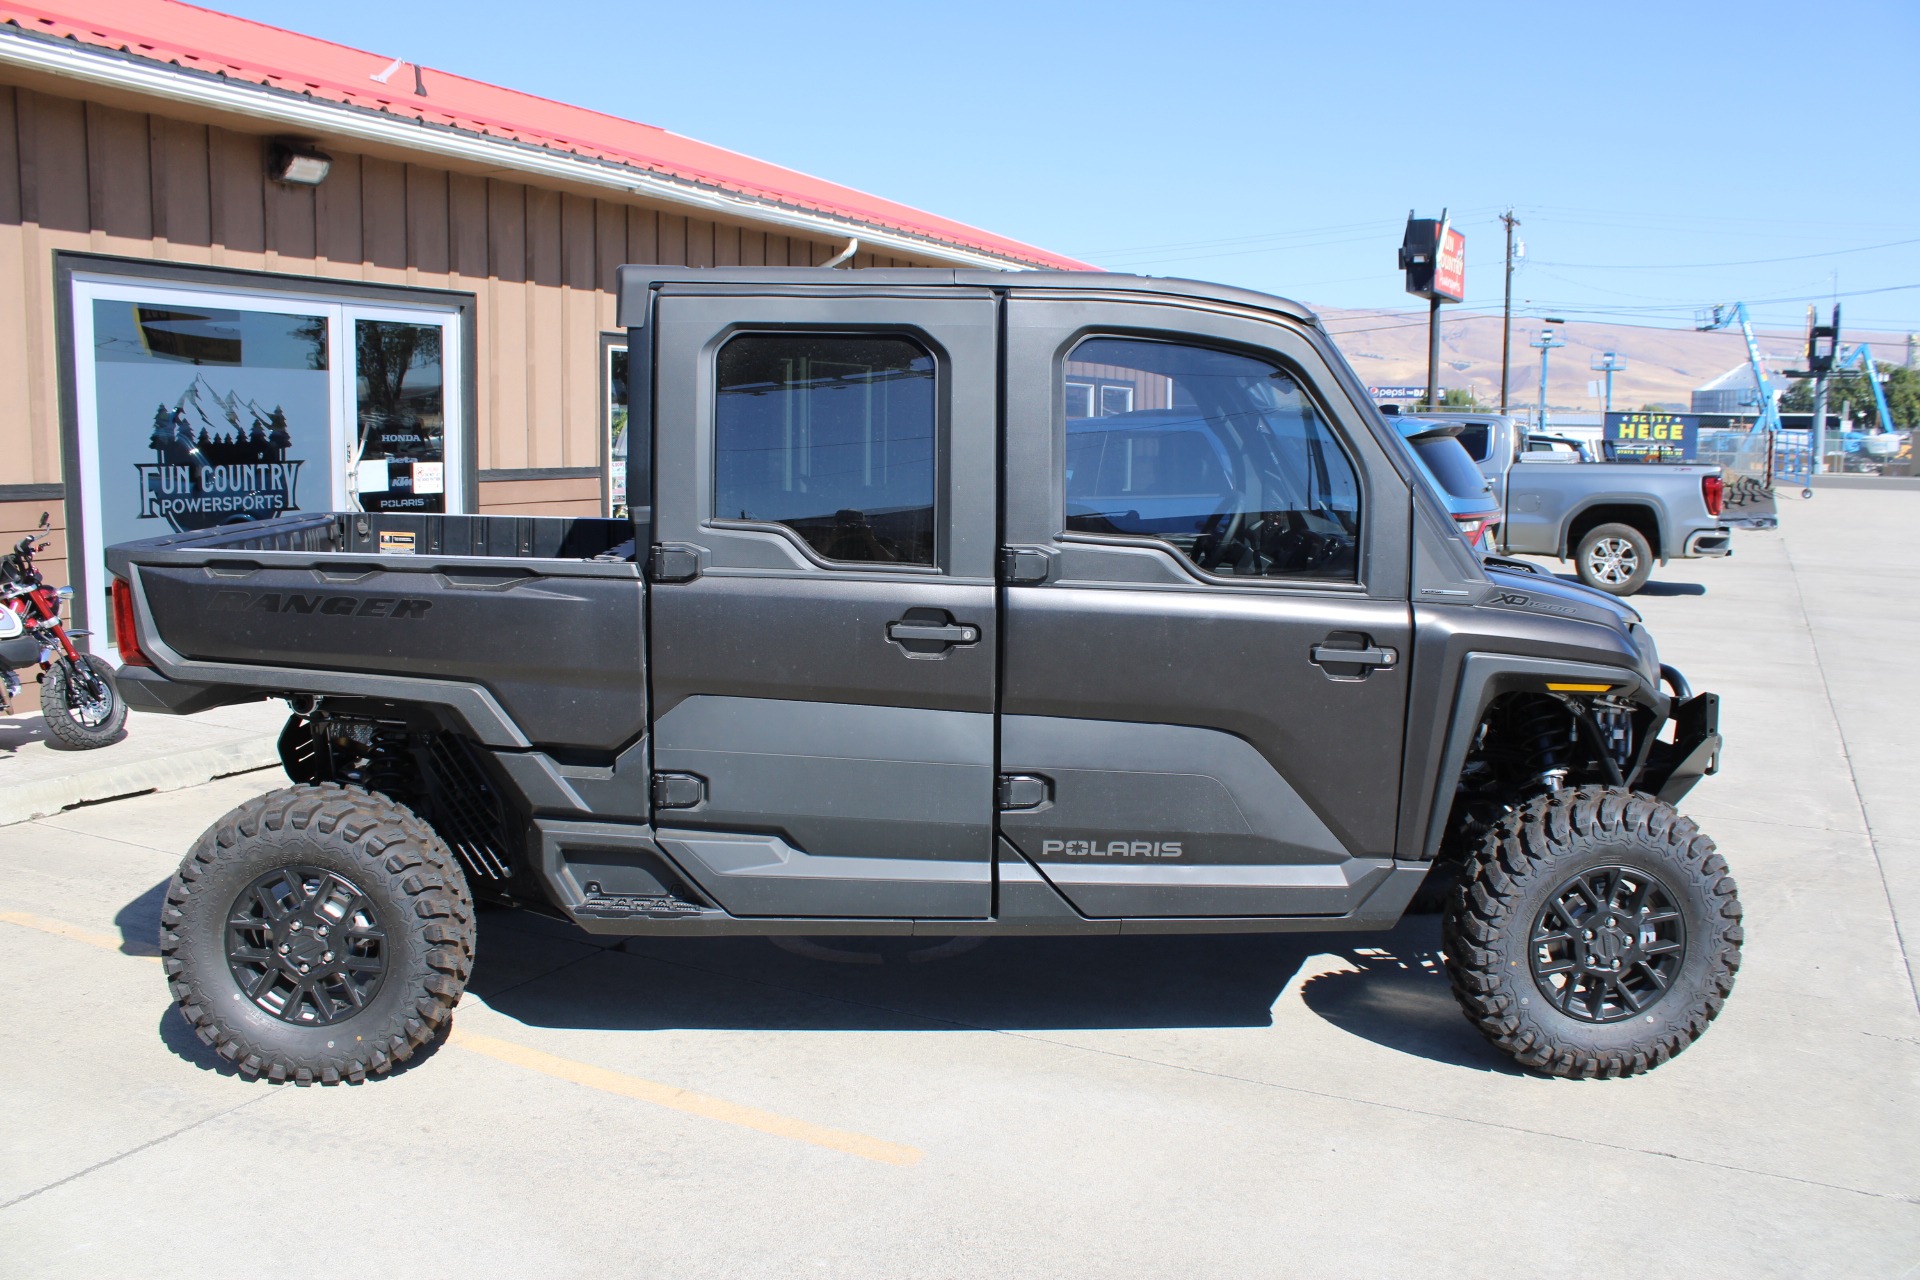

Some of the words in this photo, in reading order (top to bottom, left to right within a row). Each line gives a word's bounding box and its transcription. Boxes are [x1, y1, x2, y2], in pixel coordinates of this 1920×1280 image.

[1379, 388, 1405, 397] pepsi
[1632, 415, 1672, 423] SCOTT
[381, 434, 421, 442] HONDA
[1618, 423, 1685, 440] HEGE
[386, 456, 419, 464] Beta
[140, 465, 191, 515] FUN
[201, 463, 299, 509] COUNTRY
[161, 494, 284, 514] POWERSPORTS
[380, 498, 425, 508] POLARIS
[207, 591, 433, 620] RANGER
[1042, 840, 1183, 858] POLARIS
